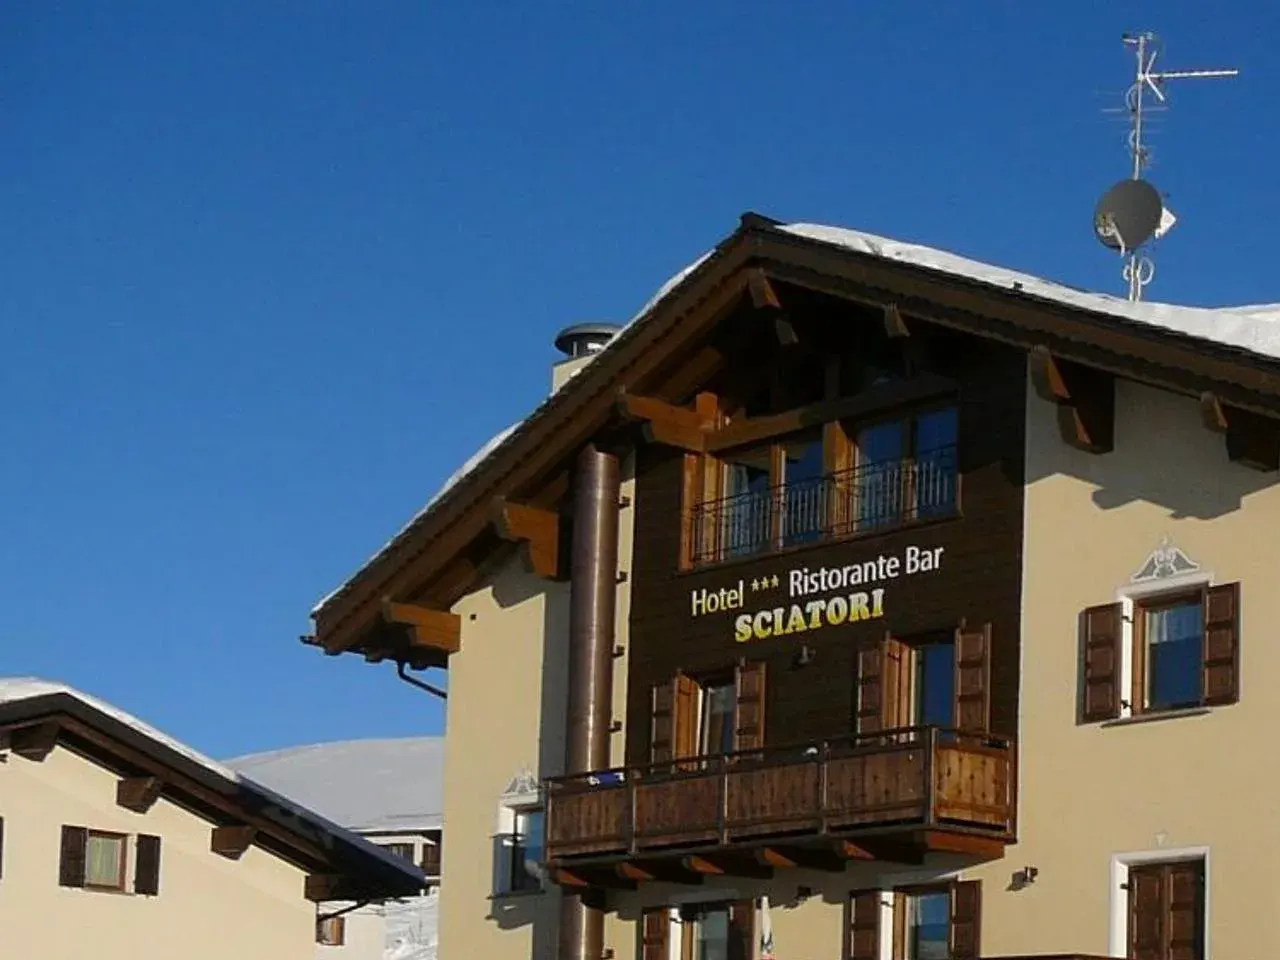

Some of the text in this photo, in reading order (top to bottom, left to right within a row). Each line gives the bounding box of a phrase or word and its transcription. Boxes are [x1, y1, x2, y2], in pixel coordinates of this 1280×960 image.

[691, 546, 944, 616] Hotel Ristorante Bar
[734, 588, 885, 642] SCIATORI
